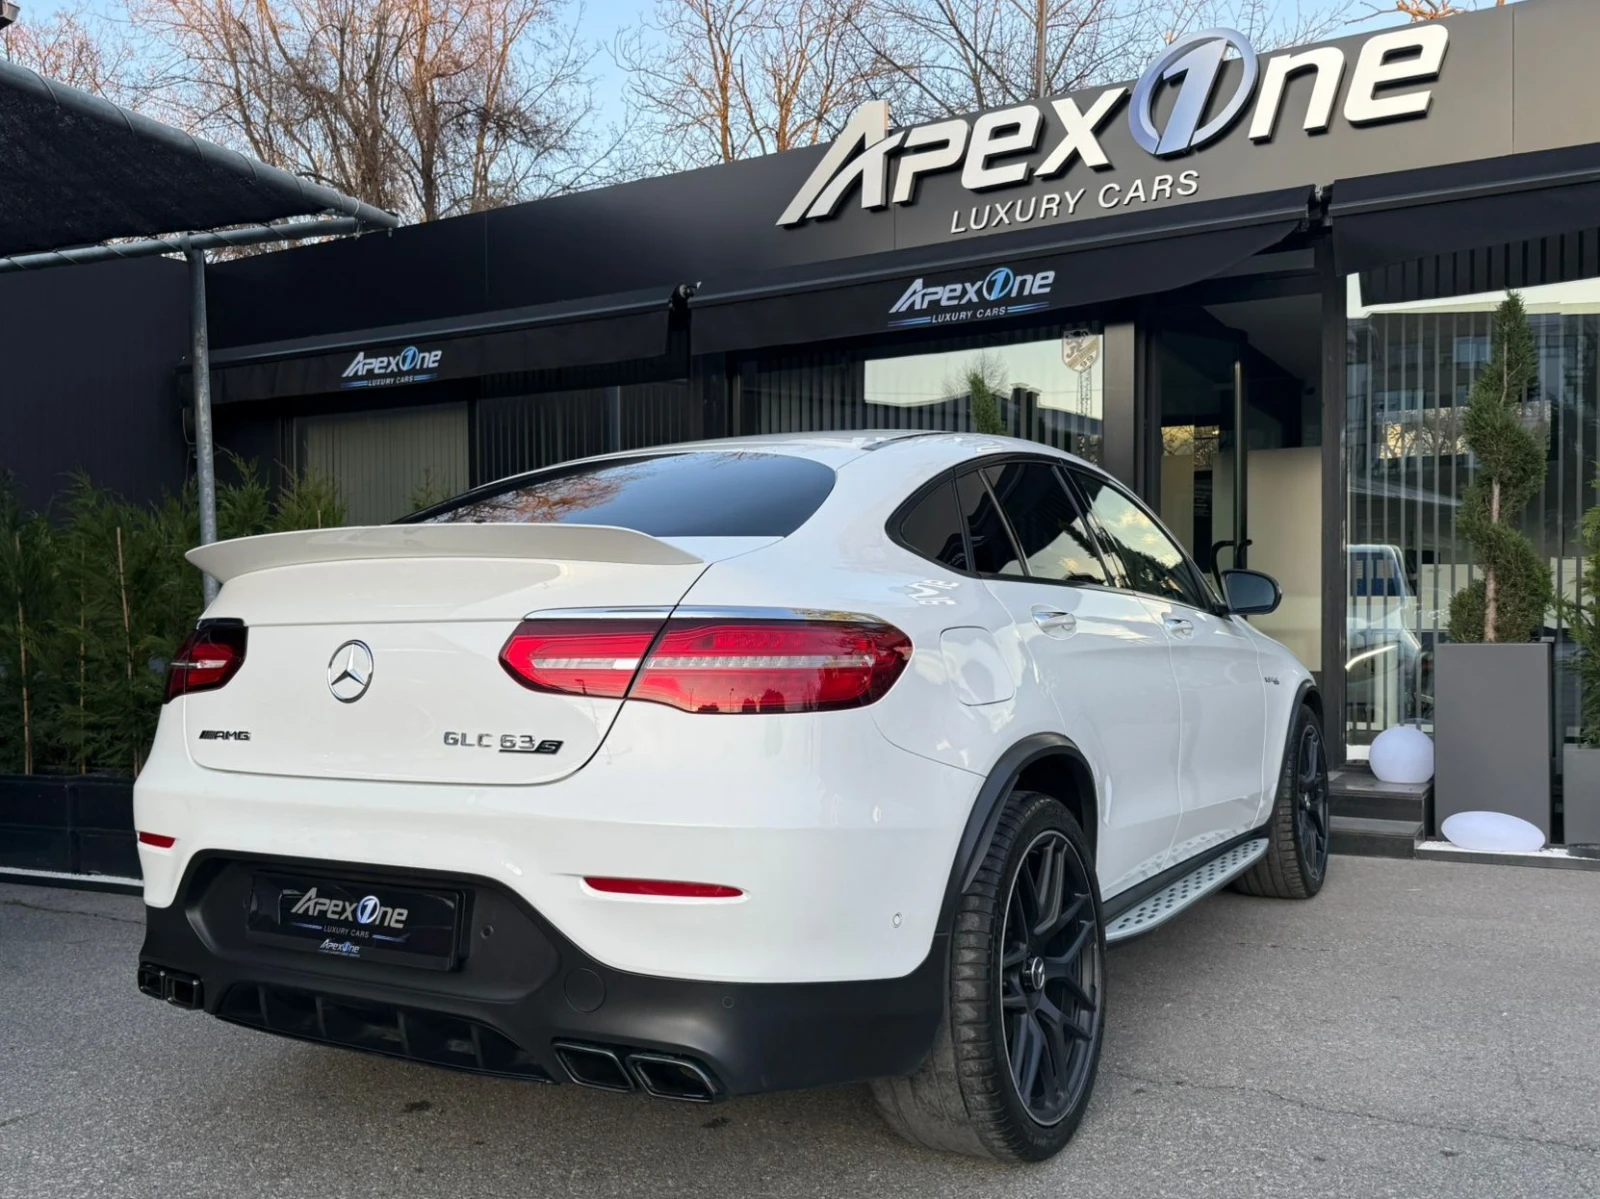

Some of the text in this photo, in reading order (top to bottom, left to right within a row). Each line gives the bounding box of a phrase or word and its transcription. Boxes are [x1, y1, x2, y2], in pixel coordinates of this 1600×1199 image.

[950, 170, 1200, 234] LUXURY CARS
[932, 306, 1007, 323] LUXURY CARS
[368, 375, 414, 387] LUXURY CARS
[443, 731, 493, 748] GLC
[323, 924, 370, 939] LUXURY CARS
